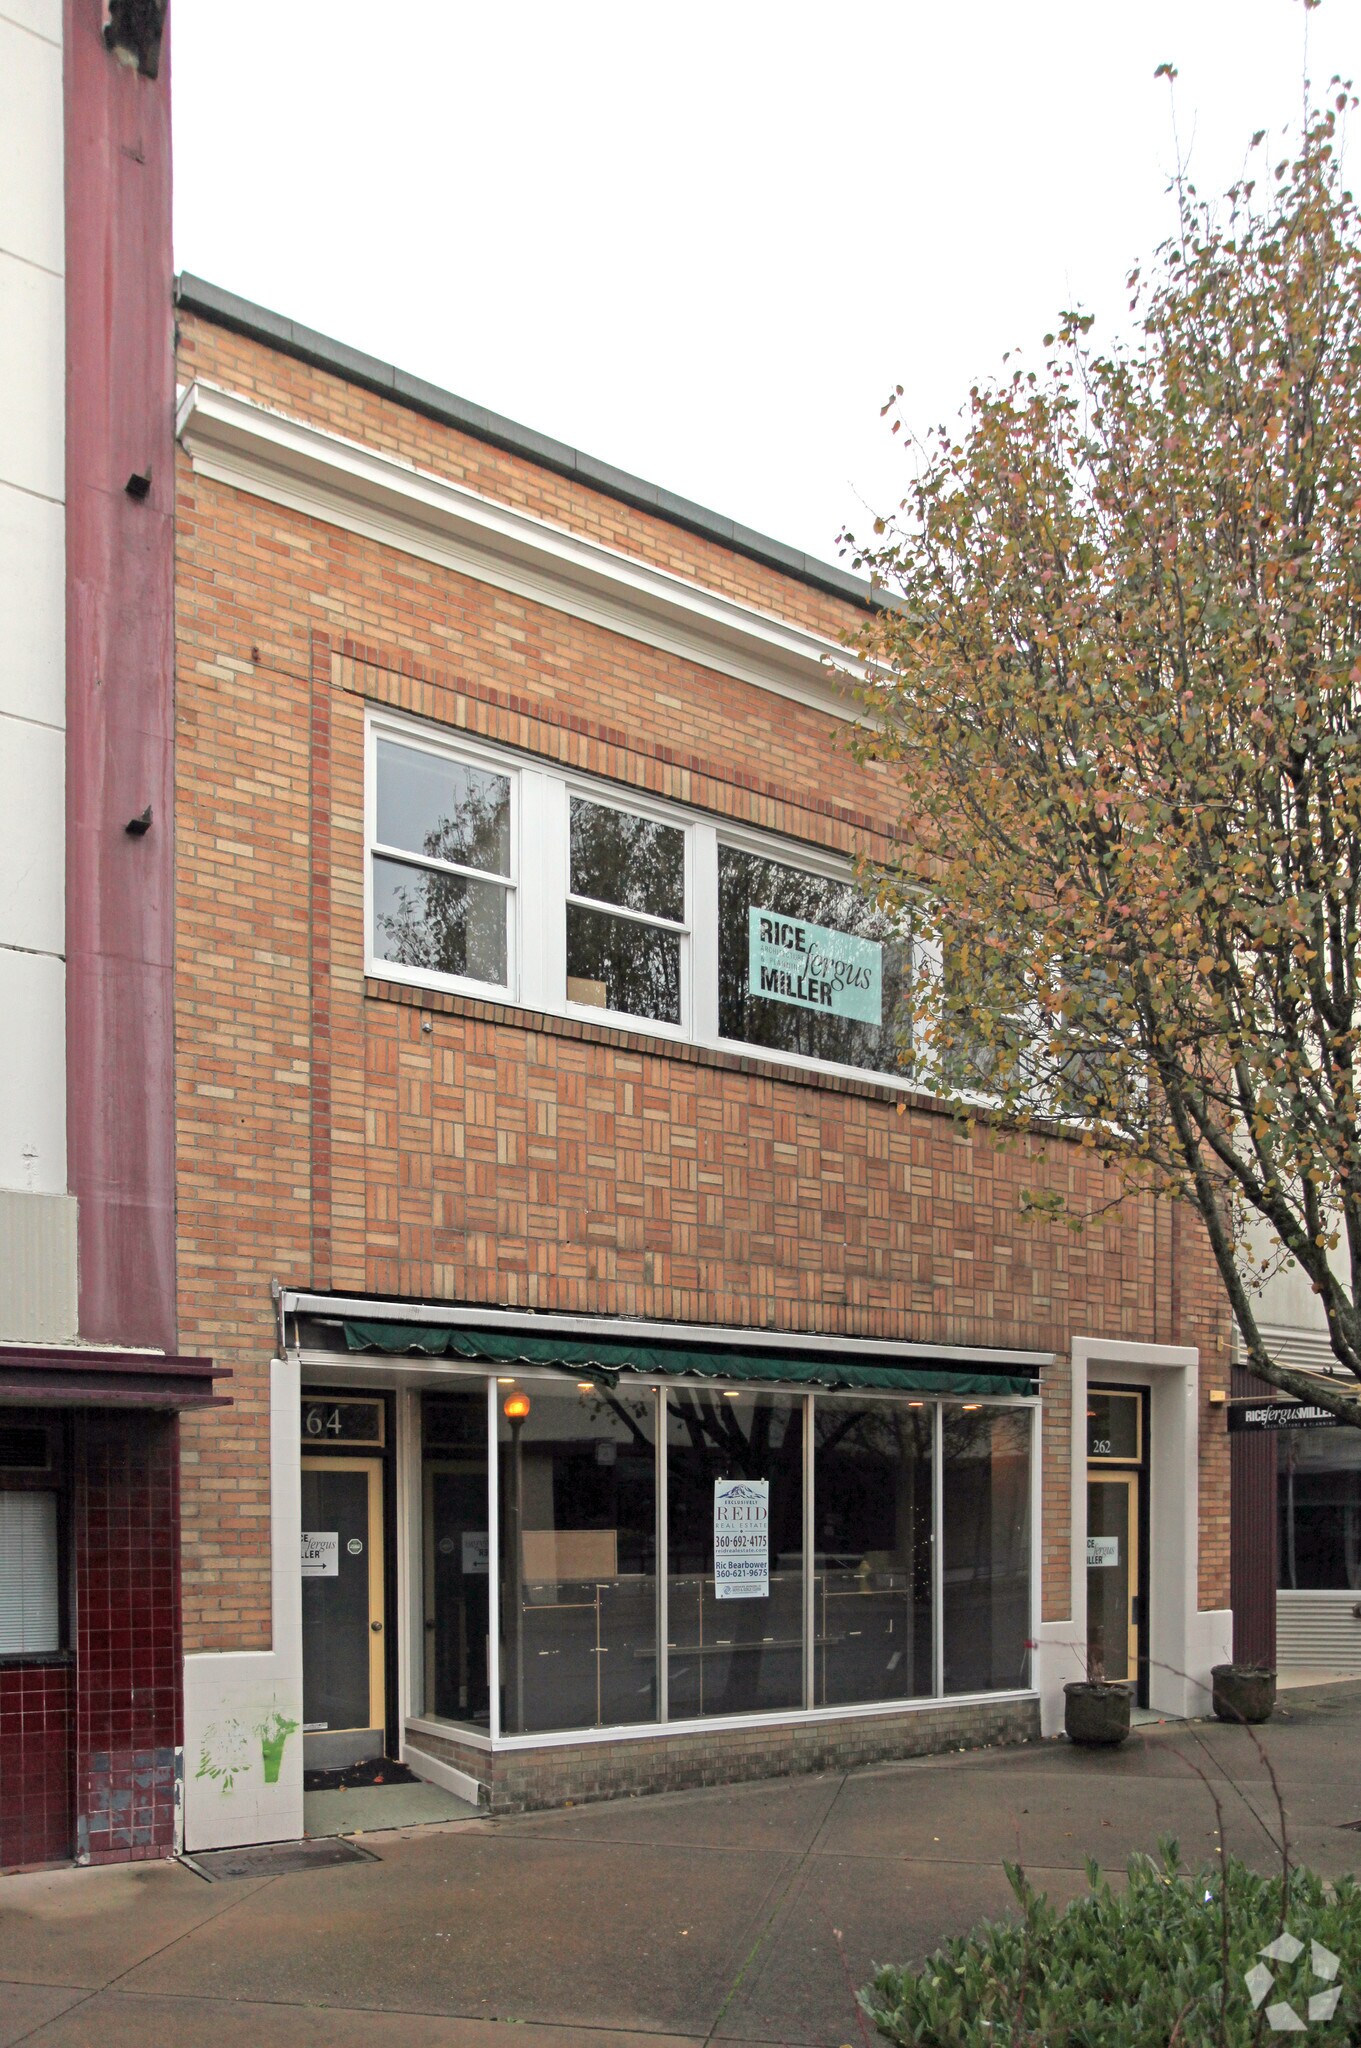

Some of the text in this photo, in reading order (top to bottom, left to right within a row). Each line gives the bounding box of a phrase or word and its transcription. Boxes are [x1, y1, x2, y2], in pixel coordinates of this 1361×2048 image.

[760, 918, 806, 953] RICE
[802, 942, 872, 992] fergus
[760, 965, 833, 1007] MILLER
[306, 1408, 342, 1435] 64
[1093, 1440, 1111, 1453] 262
[717, 1506, 767, 1521] REID
[715, 1560, 768, 1569] Ric Bearbower
[716, 1568, 768, 1578] 360-621-9675
